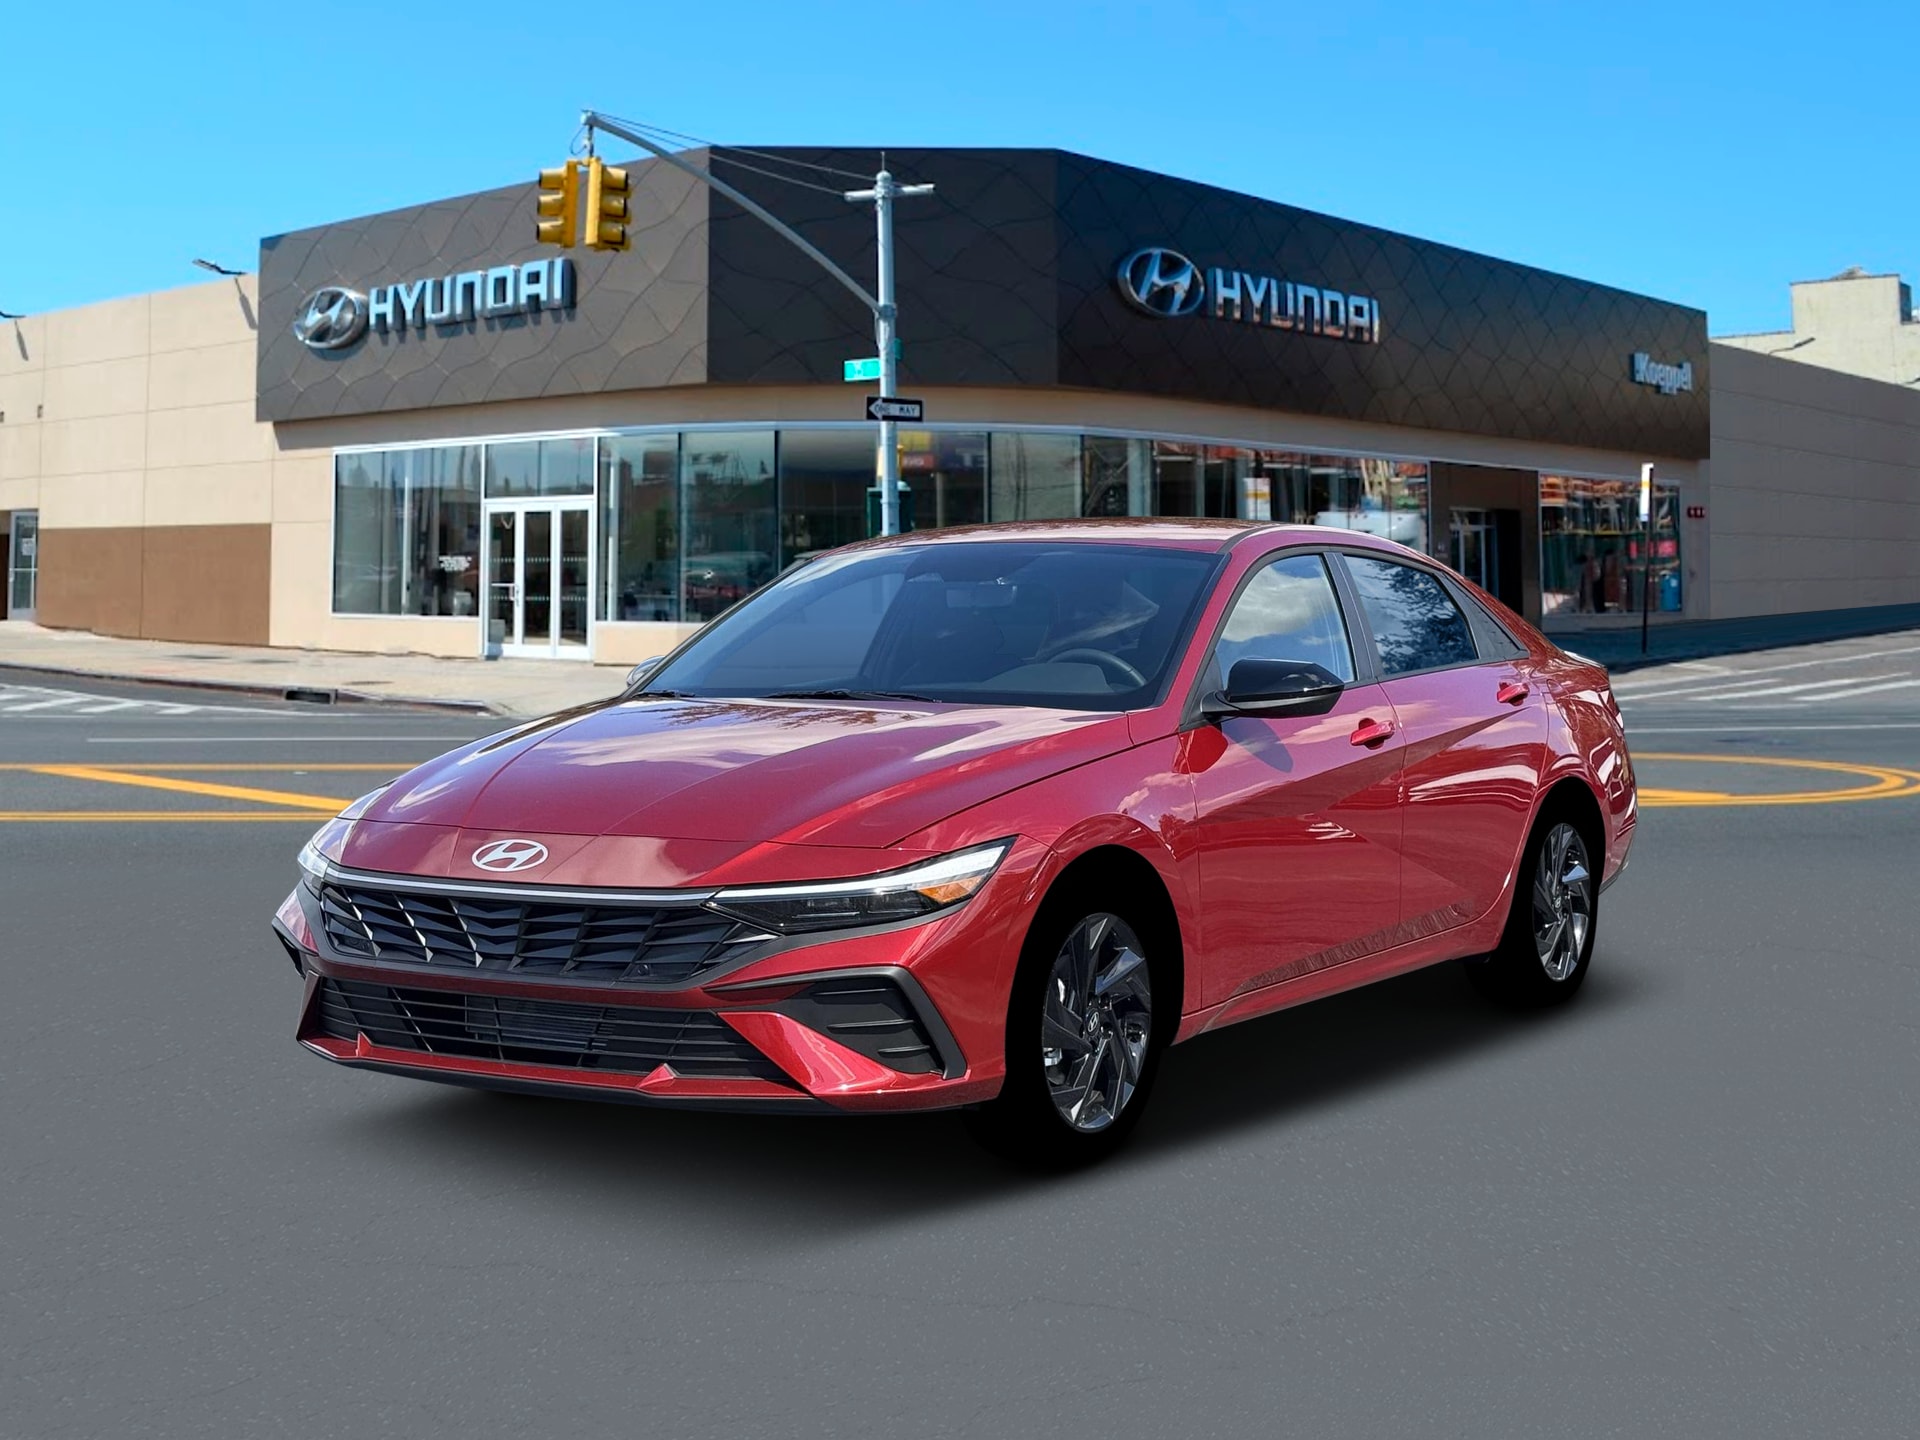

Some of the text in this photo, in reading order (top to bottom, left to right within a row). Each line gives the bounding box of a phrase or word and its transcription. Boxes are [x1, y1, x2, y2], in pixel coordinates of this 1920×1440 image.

[369, 257, 565, 328] HYUNDAI
[1214, 267, 1380, 344] HYUNDAI
[1634, 352, 1692, 395] Koeppel
[874, 403, 917, 415] ONE WAY
